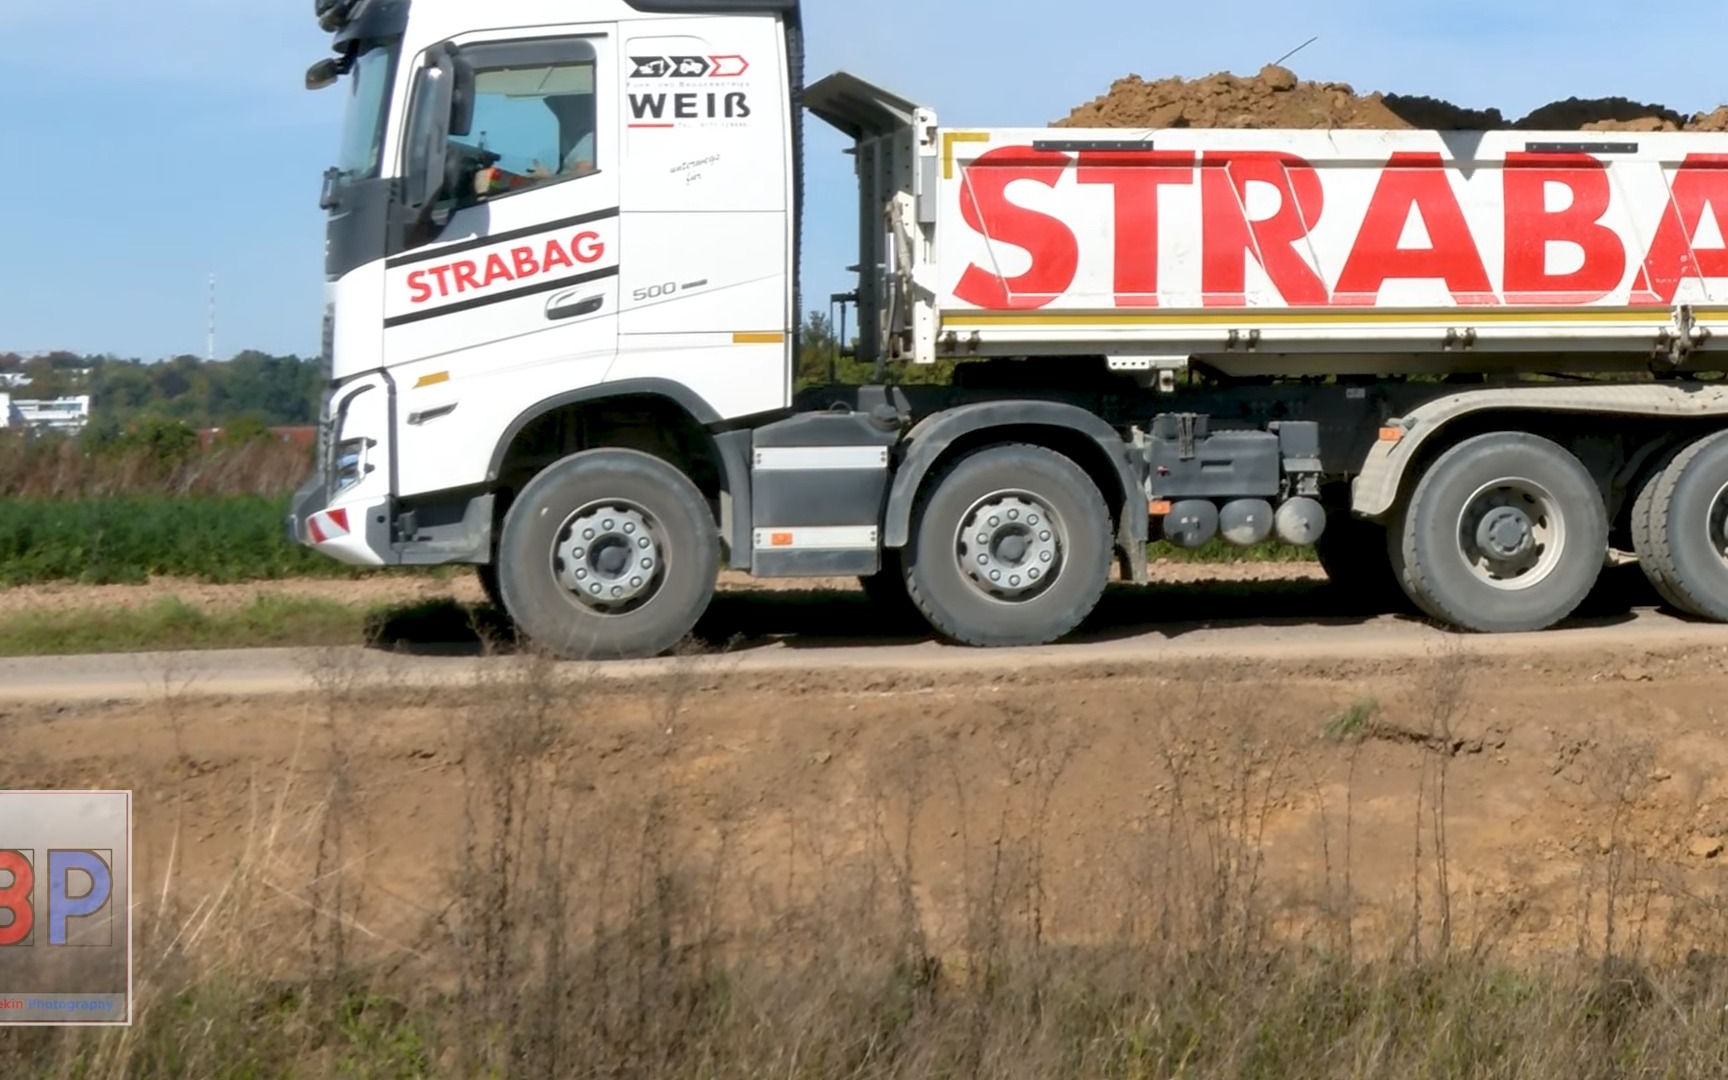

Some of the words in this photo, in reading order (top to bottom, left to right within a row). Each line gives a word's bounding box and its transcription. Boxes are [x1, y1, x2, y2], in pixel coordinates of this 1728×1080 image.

[628, 92, 751, 119] WEIß
[406, 231, 605, 303] STRABAG
[633, 281, 676, 301] 500
